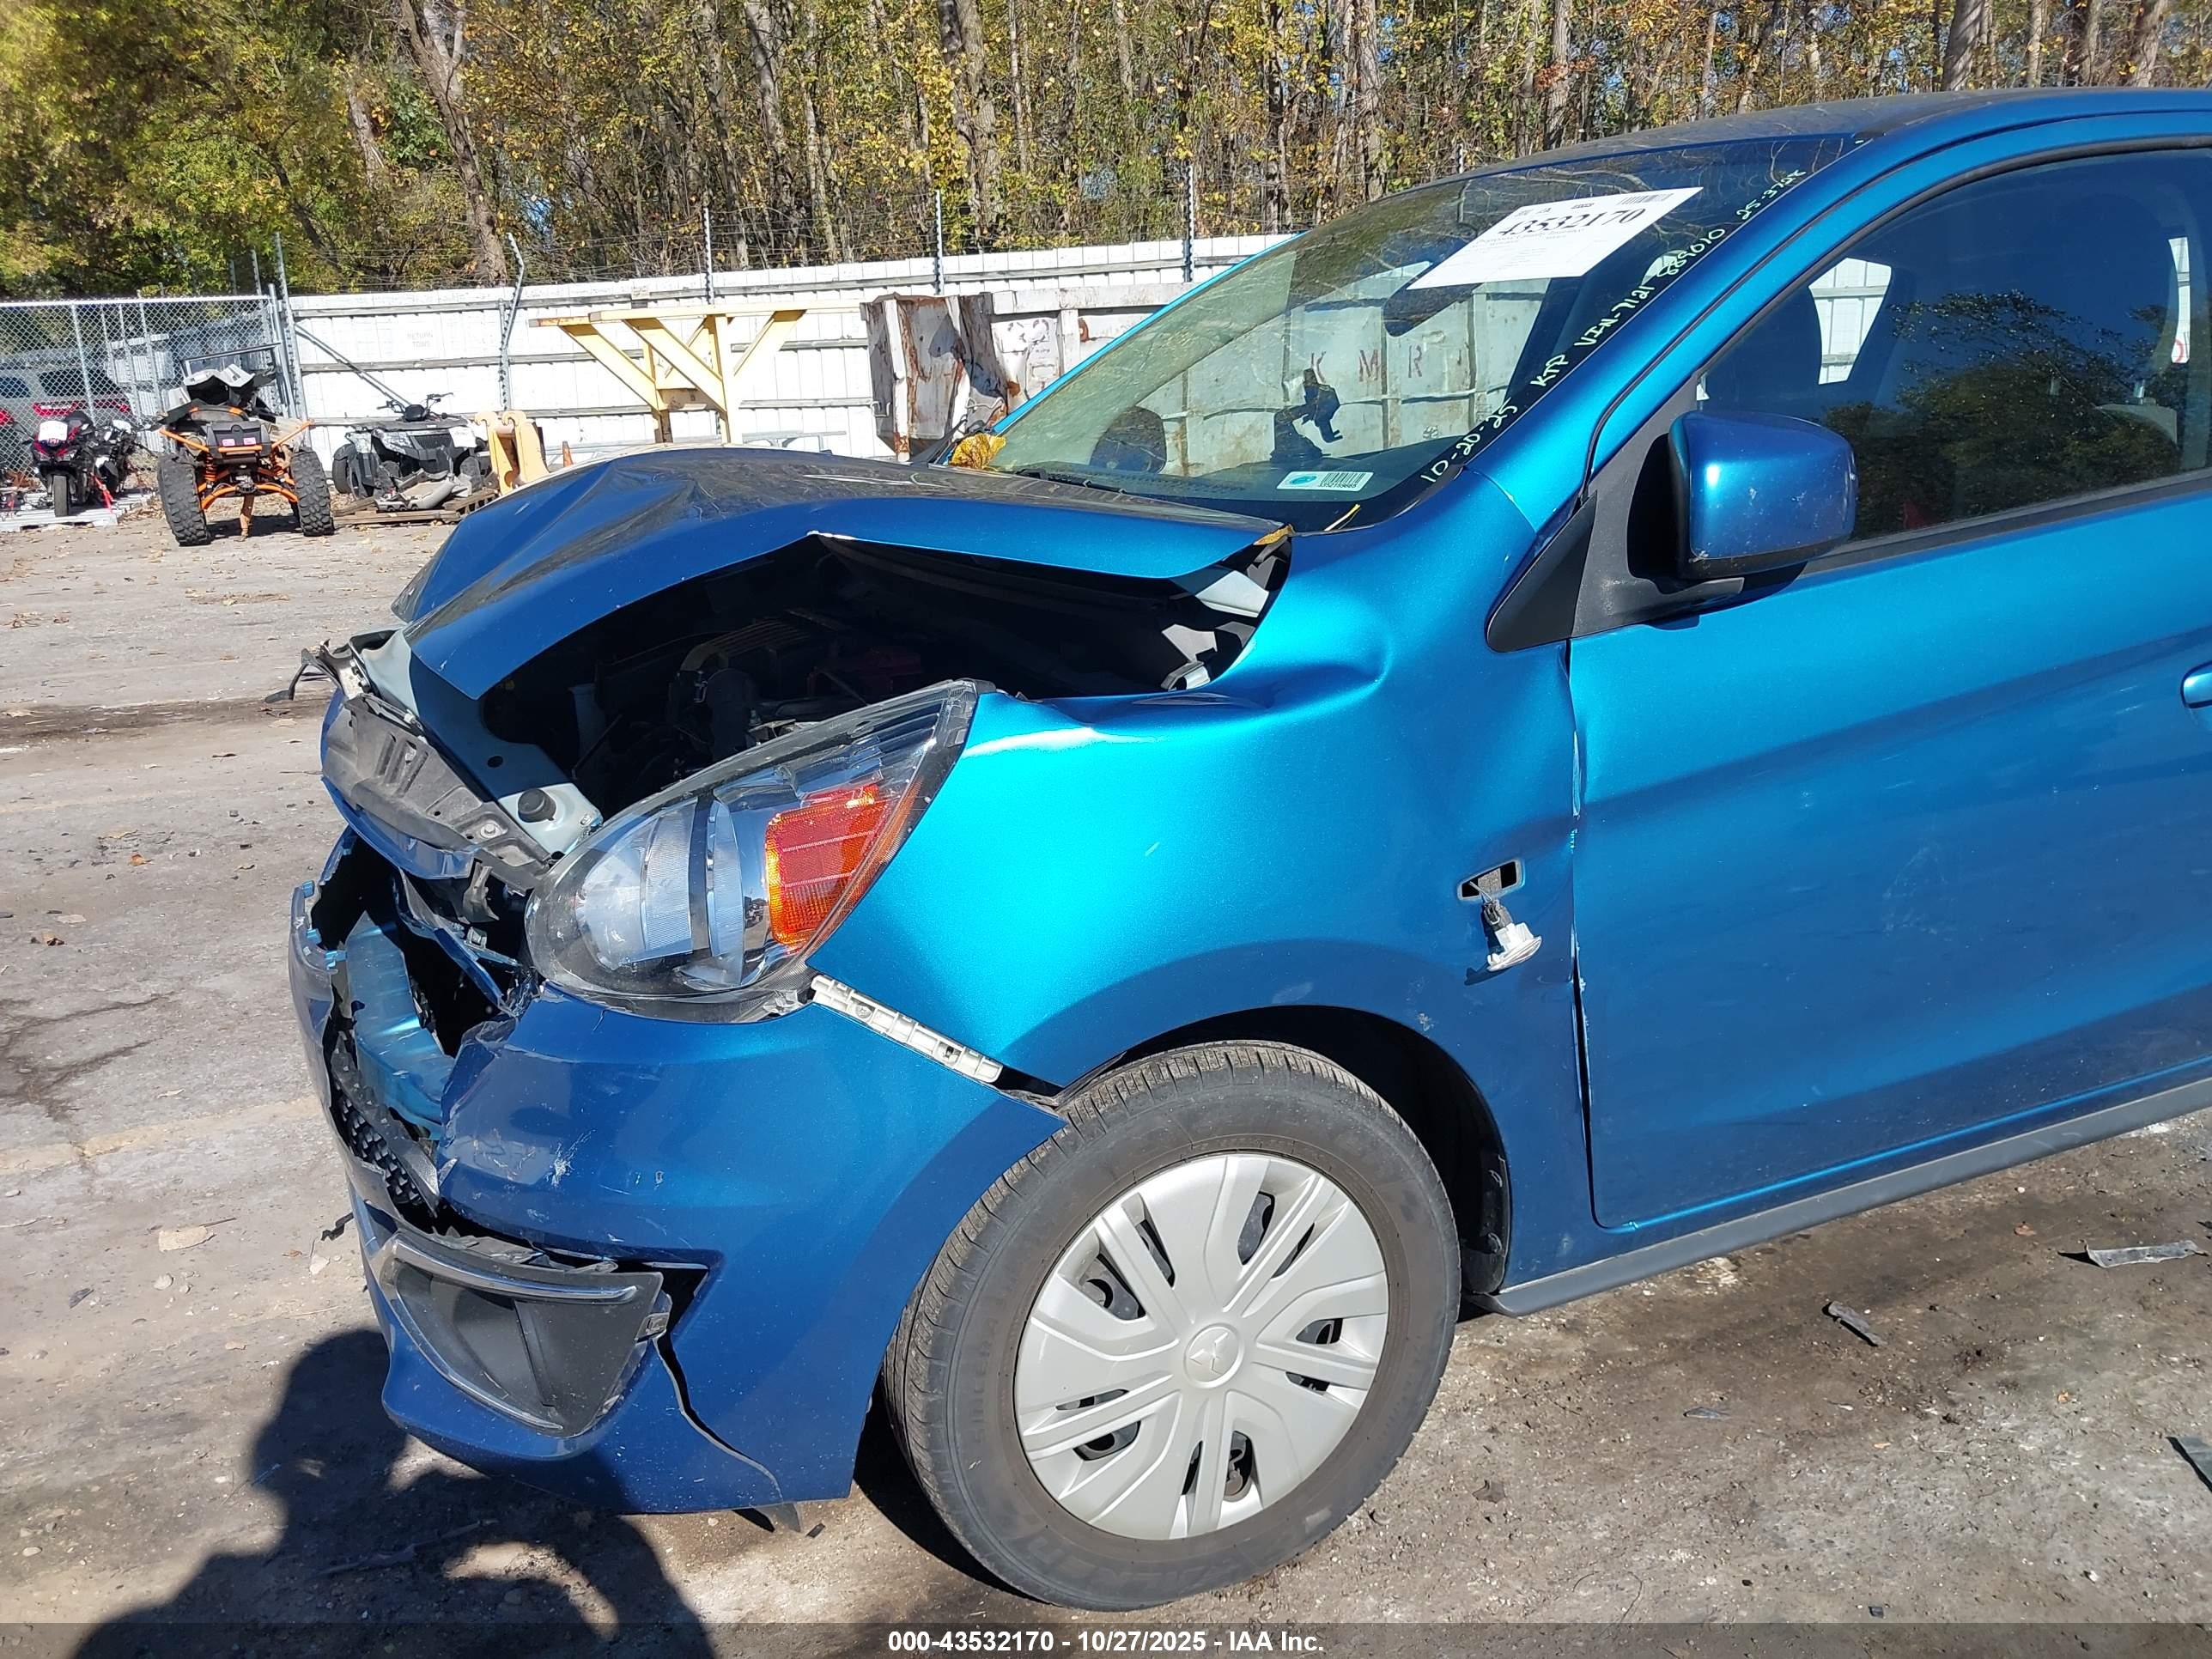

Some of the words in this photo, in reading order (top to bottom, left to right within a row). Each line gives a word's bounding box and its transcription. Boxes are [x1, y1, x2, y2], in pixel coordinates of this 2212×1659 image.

[1498, 208, 1646, 236] 43532170
[1358, 349, 1382, 383] M
[1407, 344, 1423, 379] R
[1420, 397, 1518, 483] 10-20-25
[1573, 285, 1656, 346] VIN-7121
